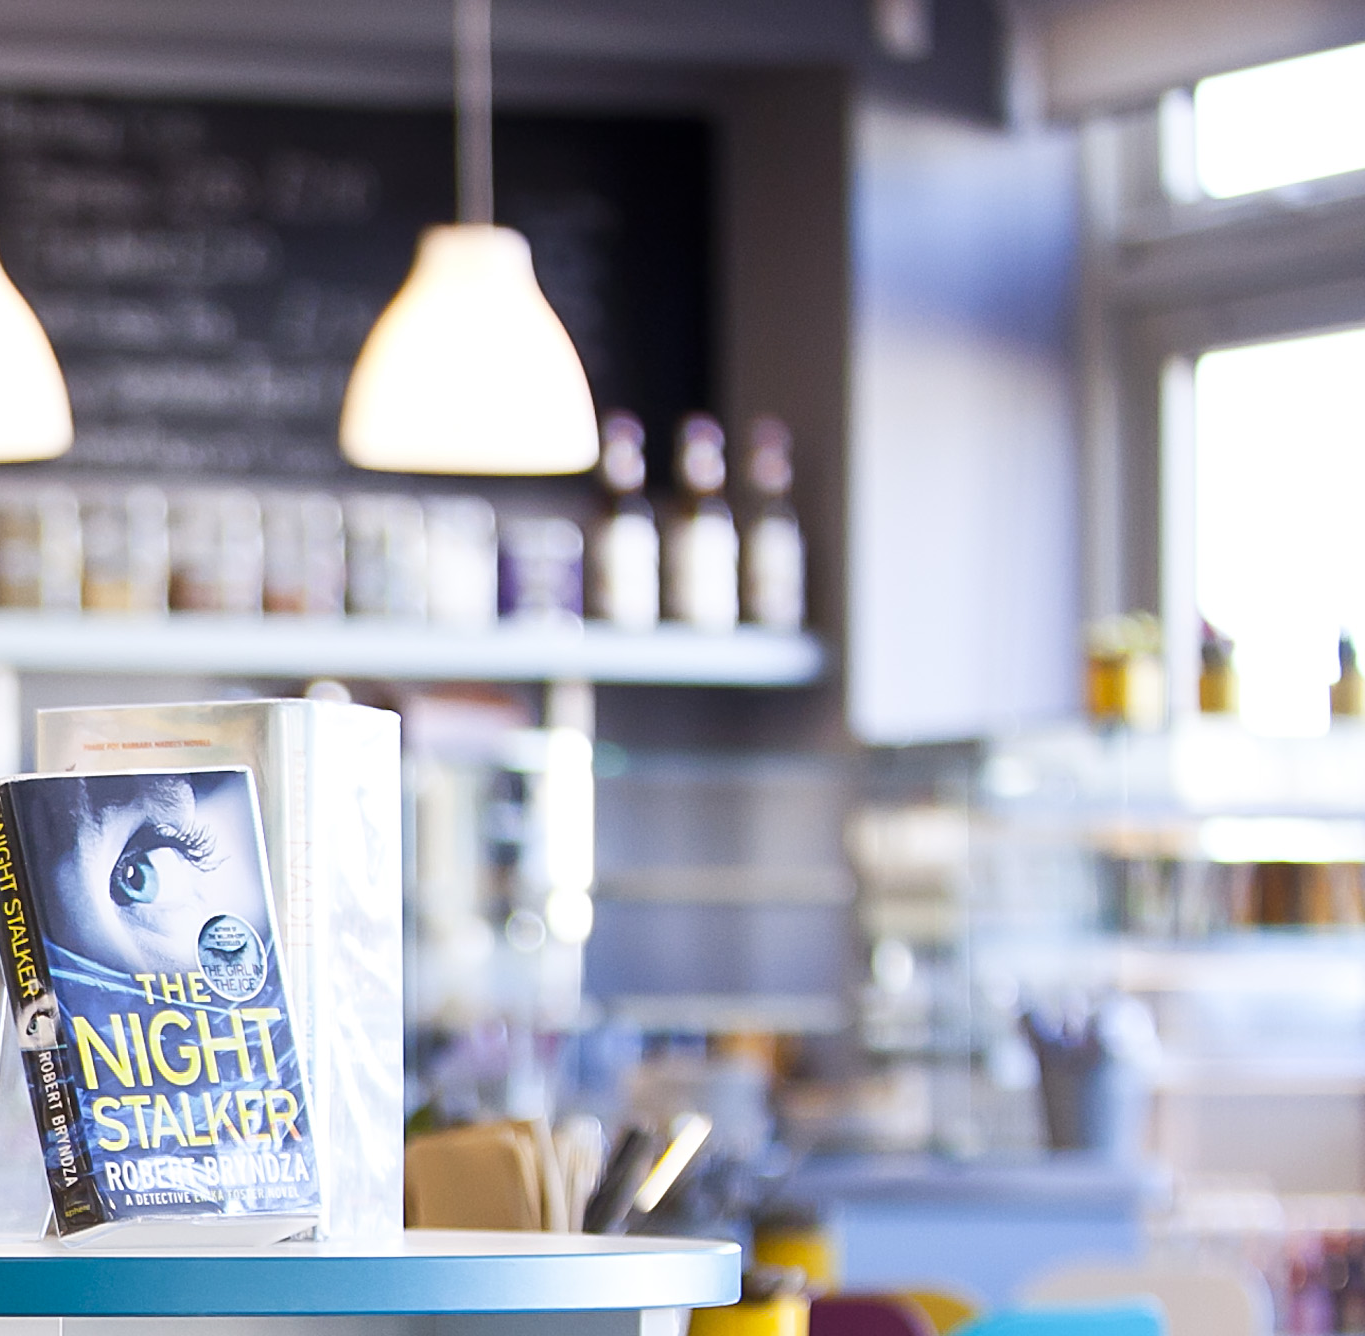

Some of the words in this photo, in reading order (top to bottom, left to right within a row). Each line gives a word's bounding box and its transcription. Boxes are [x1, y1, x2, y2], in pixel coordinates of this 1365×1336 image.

[4, 898, 40, 998] STALKER
[134, 971, 212, 1005] THE
[202, 964, 223, 977] THE
[225, 963, 251, 977] GIRL
[252, 964, 264, 975] IN
[214, 979, 236, 991] THE
[238, 978, 257, 991] ICE
[72, 1008, 281, 1090] NIGHT
[39, 1051, 63, 1110] ROBERT
[51, 1114, 79, 1187] BRYNDZA
[92, 1089, 303, 1152] STALKER
[105, 1157, 196, 1191] ROBERT
[203, 1153, 310, 1186] BRYNDZA
[126, 1194, 133, 1206] A
[135, 1192, 191, 1206] DETECTIVE
